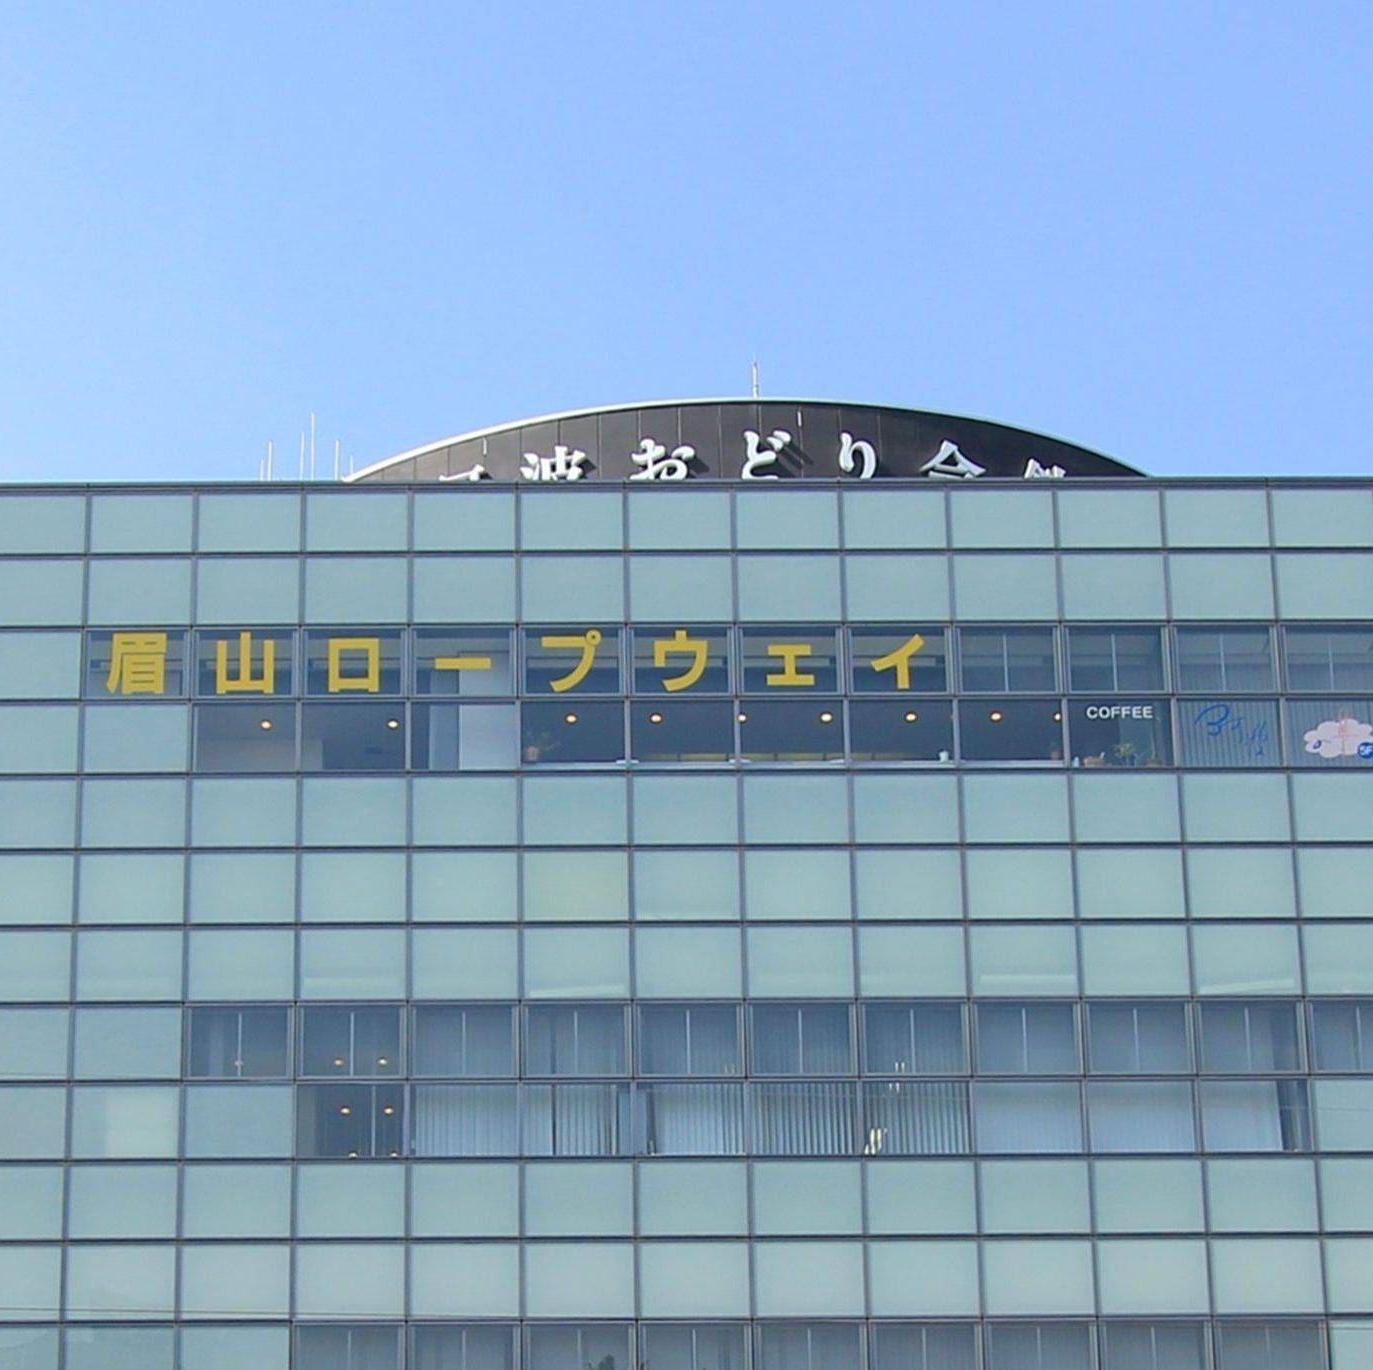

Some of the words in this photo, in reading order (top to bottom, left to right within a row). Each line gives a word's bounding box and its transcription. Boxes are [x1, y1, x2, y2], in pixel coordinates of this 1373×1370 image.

[439, 430, 1065, 480] 波おどり会
[1086, 706, 1153, 719] COFFEE
